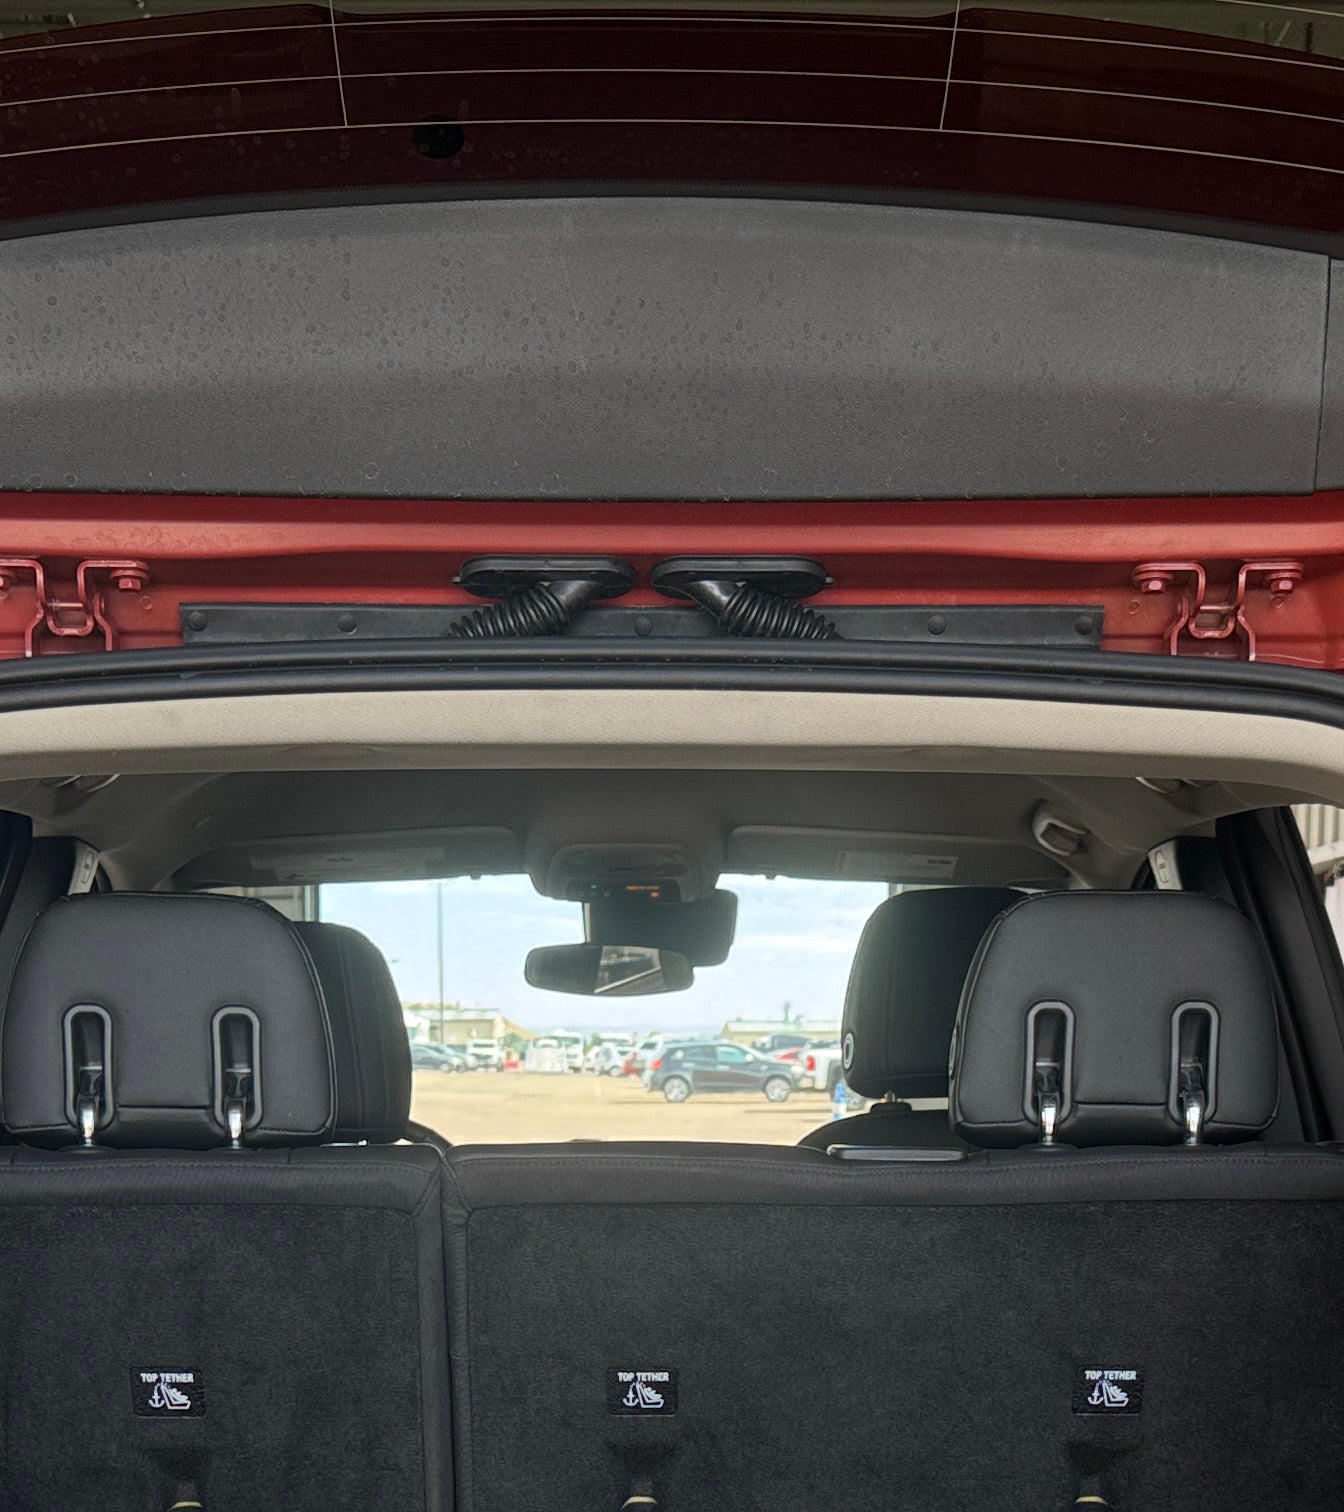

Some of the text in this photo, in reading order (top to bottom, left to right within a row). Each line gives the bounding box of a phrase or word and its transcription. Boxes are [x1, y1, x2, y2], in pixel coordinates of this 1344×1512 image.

[140, 1372, 194, 1383] TOP TETHER
[617, 1371, 669, 1382] TOP TETHER
[1084, 1370, 1137, 1380] TOP TETHER
